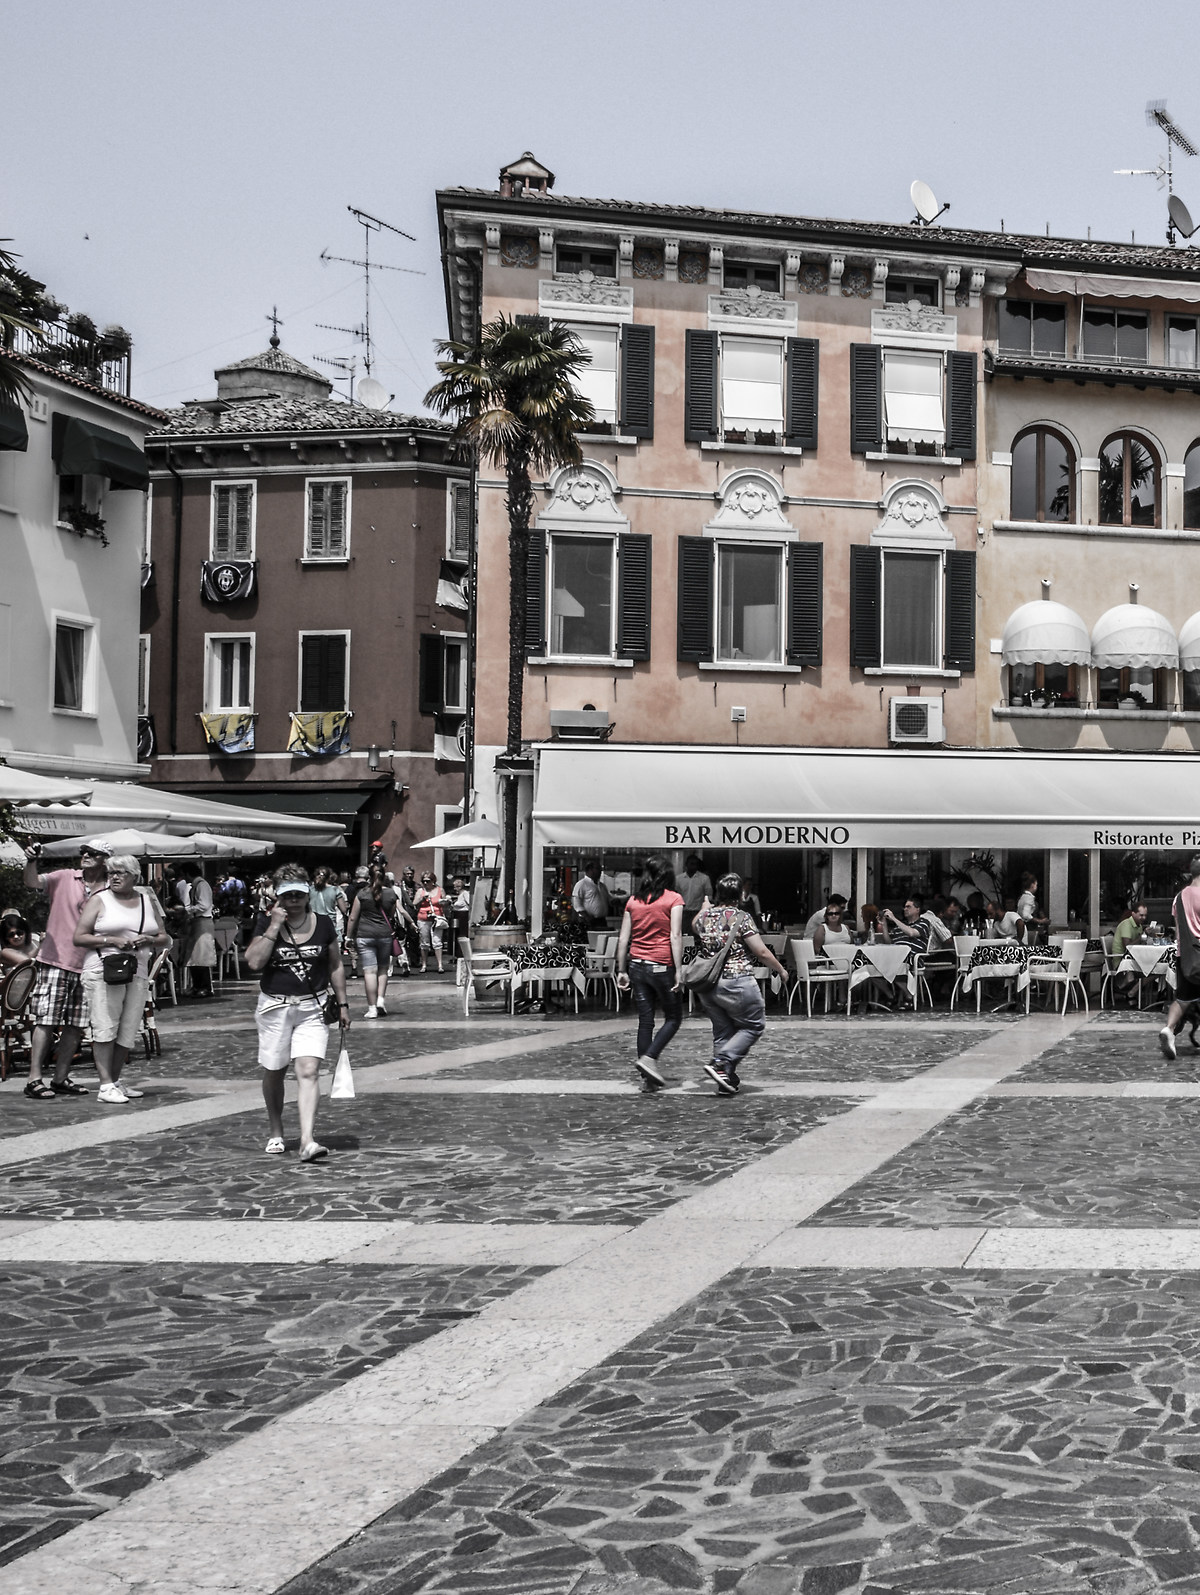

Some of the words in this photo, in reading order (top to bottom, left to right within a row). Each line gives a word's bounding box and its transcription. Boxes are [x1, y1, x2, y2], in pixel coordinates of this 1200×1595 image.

[665, 825, 712, 844] BAR
[722, 825, 850, 845] MODERNO
[1093, 830, 1174, 846] Ristorante
